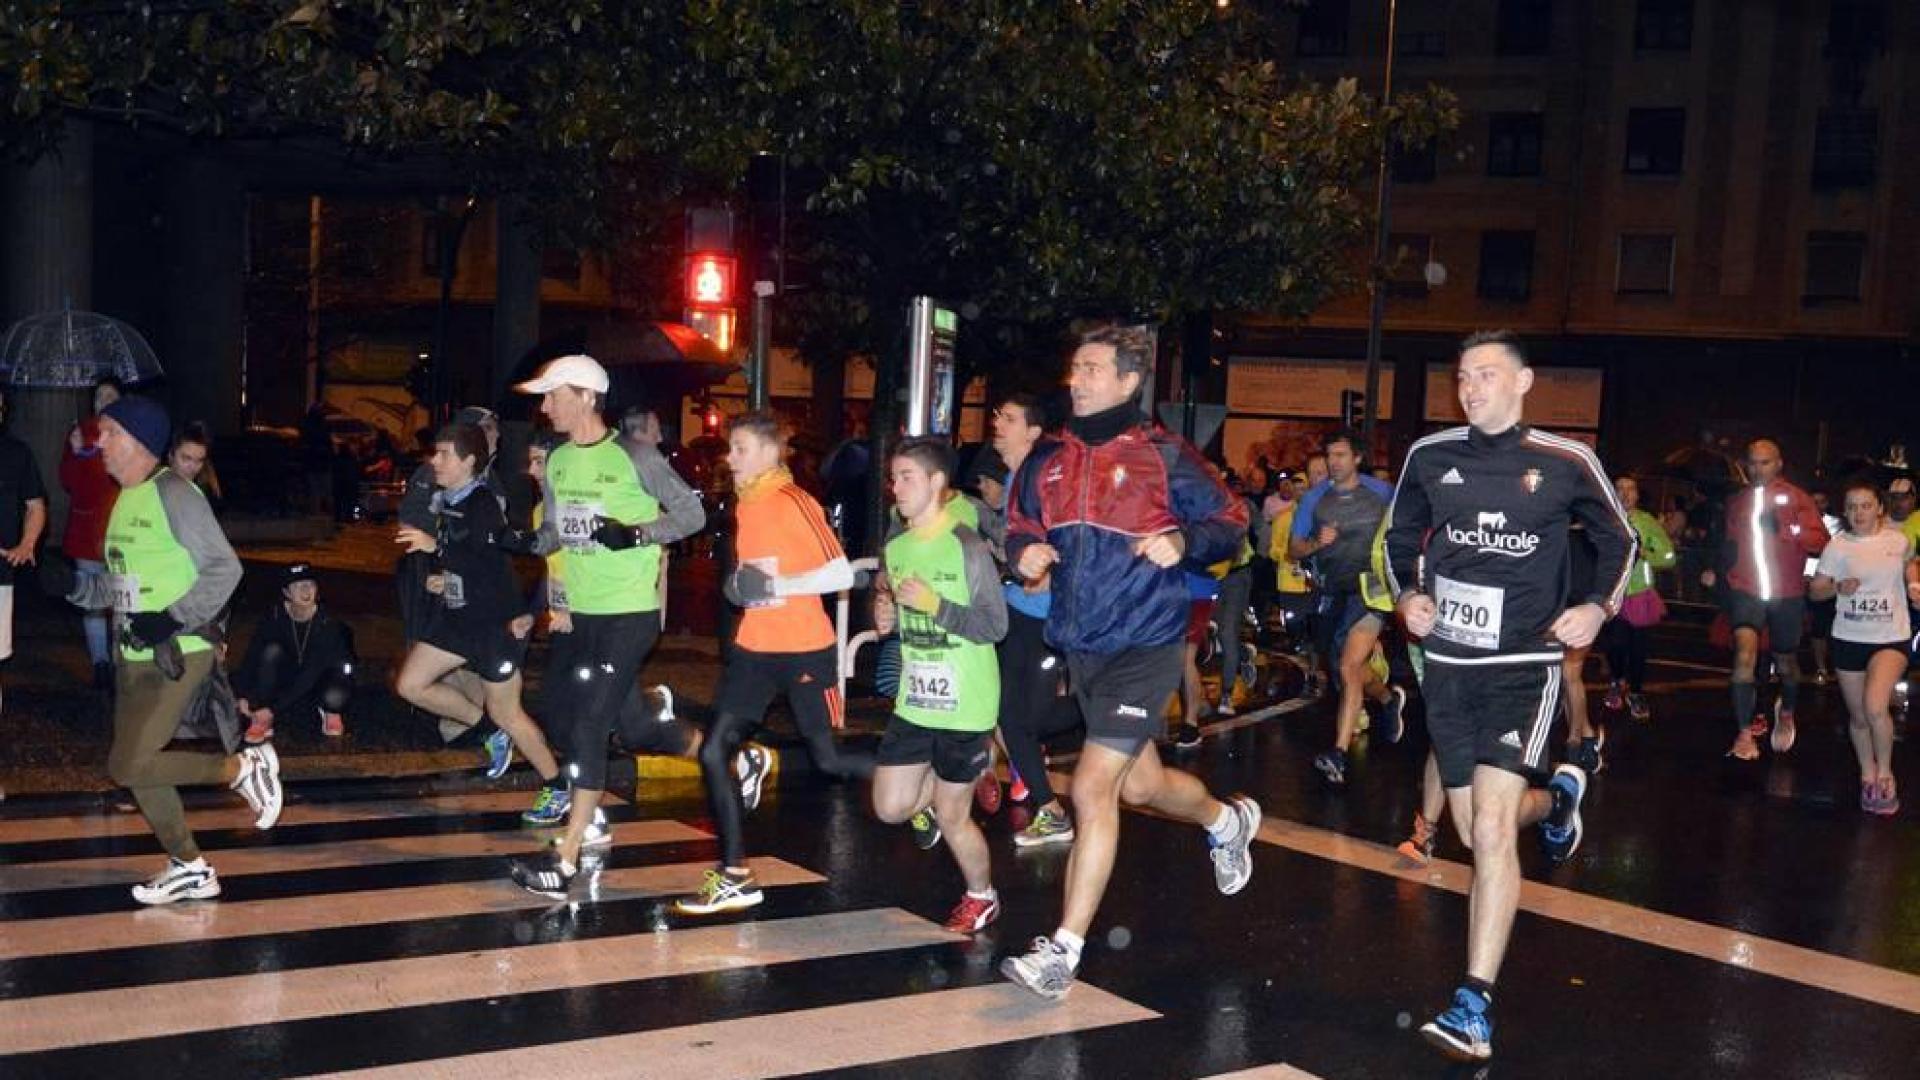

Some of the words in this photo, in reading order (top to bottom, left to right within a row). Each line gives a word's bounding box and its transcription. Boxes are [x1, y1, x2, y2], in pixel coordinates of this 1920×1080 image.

[1438, 597, 1490, 628] 4790
[1850, 598, 1889, 613] 1424
[908, 674, 950, 697] 3142
